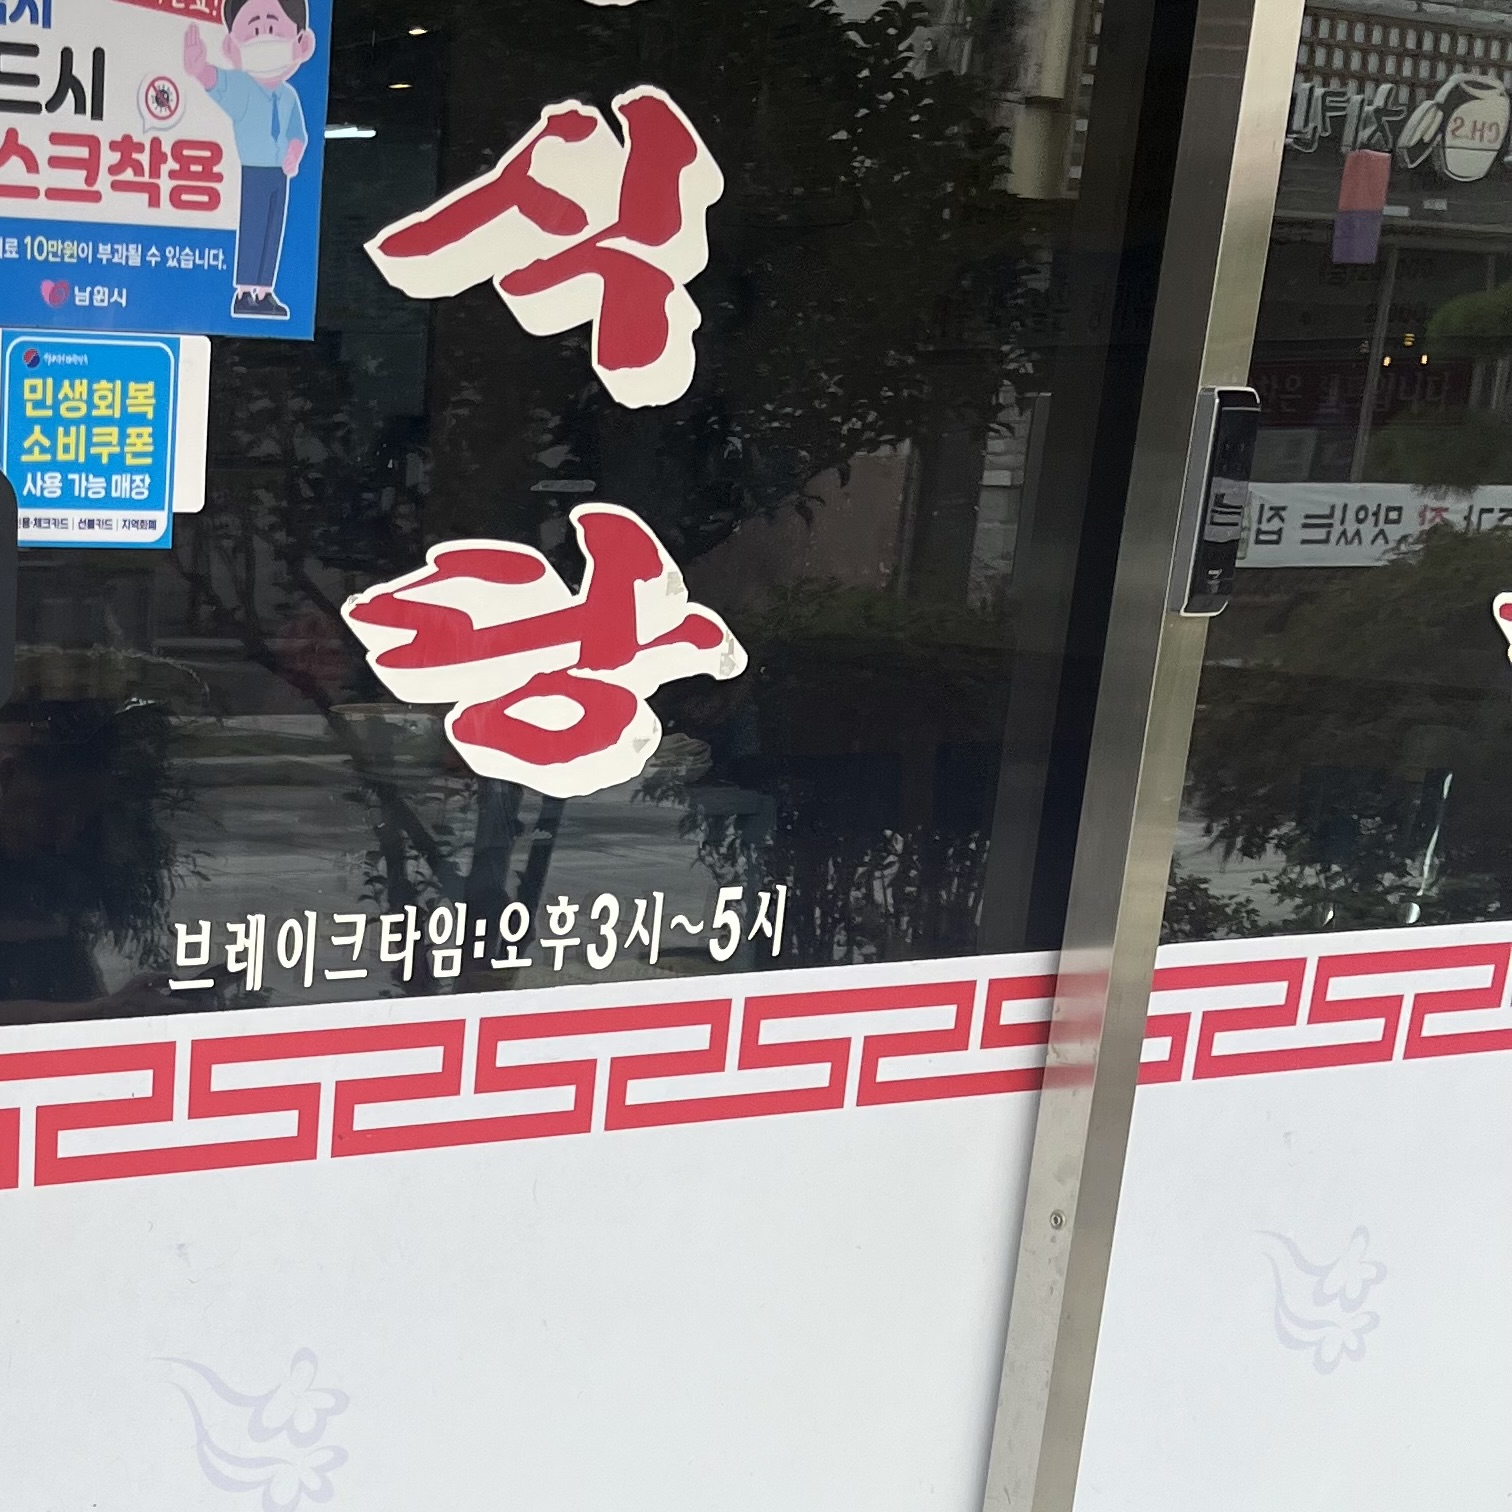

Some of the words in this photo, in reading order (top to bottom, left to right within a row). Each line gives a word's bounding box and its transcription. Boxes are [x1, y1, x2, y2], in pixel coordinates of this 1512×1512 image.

[24, 236, 93, 264] 10만원이
[97, 242, 143, 267] 부과될
[146, 245, 162, 268] 수
[165, 246, 228, 271] 있습니다.
[74, 286, 128, 308] 남원시
[22, 378, 156, 420] 민생회복
[21, 425, 155, 465] 소비쿠폰
[22, 472, 63, 498] 사용
[68, 473, 107, 498] 가능
[112, 475, 151, 500] 매장
[19, 517, 69, 530] 용·체크카드
[121, 519, 157, 531] 지역화폐
[169, 884, 788, 992] 브레이크타임:오후3시~5시
